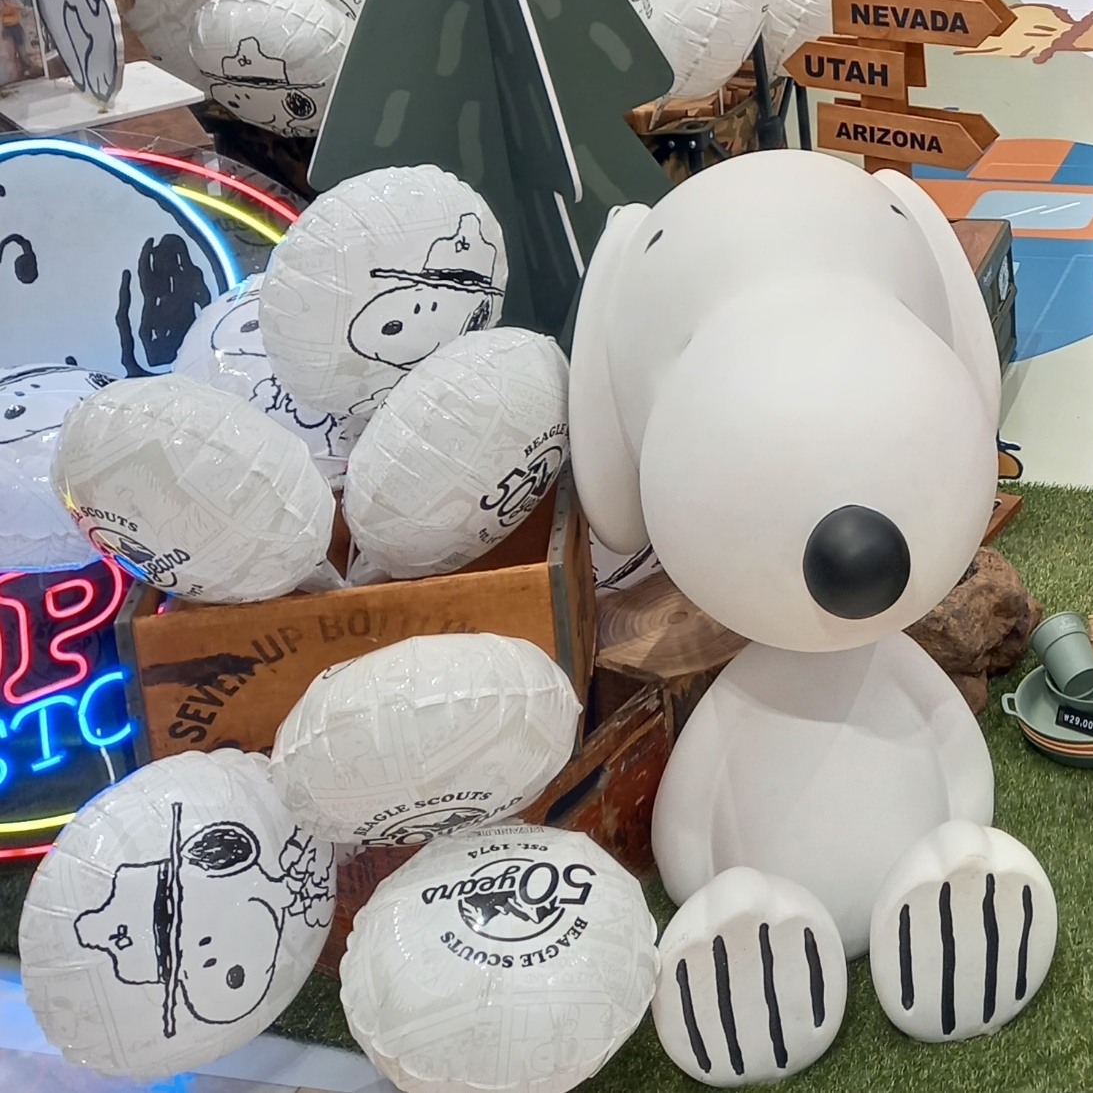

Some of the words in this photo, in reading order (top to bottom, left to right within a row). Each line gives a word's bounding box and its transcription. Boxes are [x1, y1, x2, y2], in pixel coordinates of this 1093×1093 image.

[851, 3, 970, 35] NEVADA
[804, 54, 889, 87] UTAH
[836, 121, 944, 154] ARIZONA
[480, 467, 537, 518] 50
[80, 506, 139, 533] SCOUTS
[168, 672, 248, 744] SEVE
[251, 625, 303, 666] UP
[353, 804, 411, 836] BEAGLE
[413, 790, 493, 809] SCOUTS
[467, 843, 510, 859] 1974
[421, 865, 521, 905] years
[519, 861, 597, 905] 50
[440, 930, 515, 969] SCOUTS
[520, 916, 589, 968] BEAGLE
